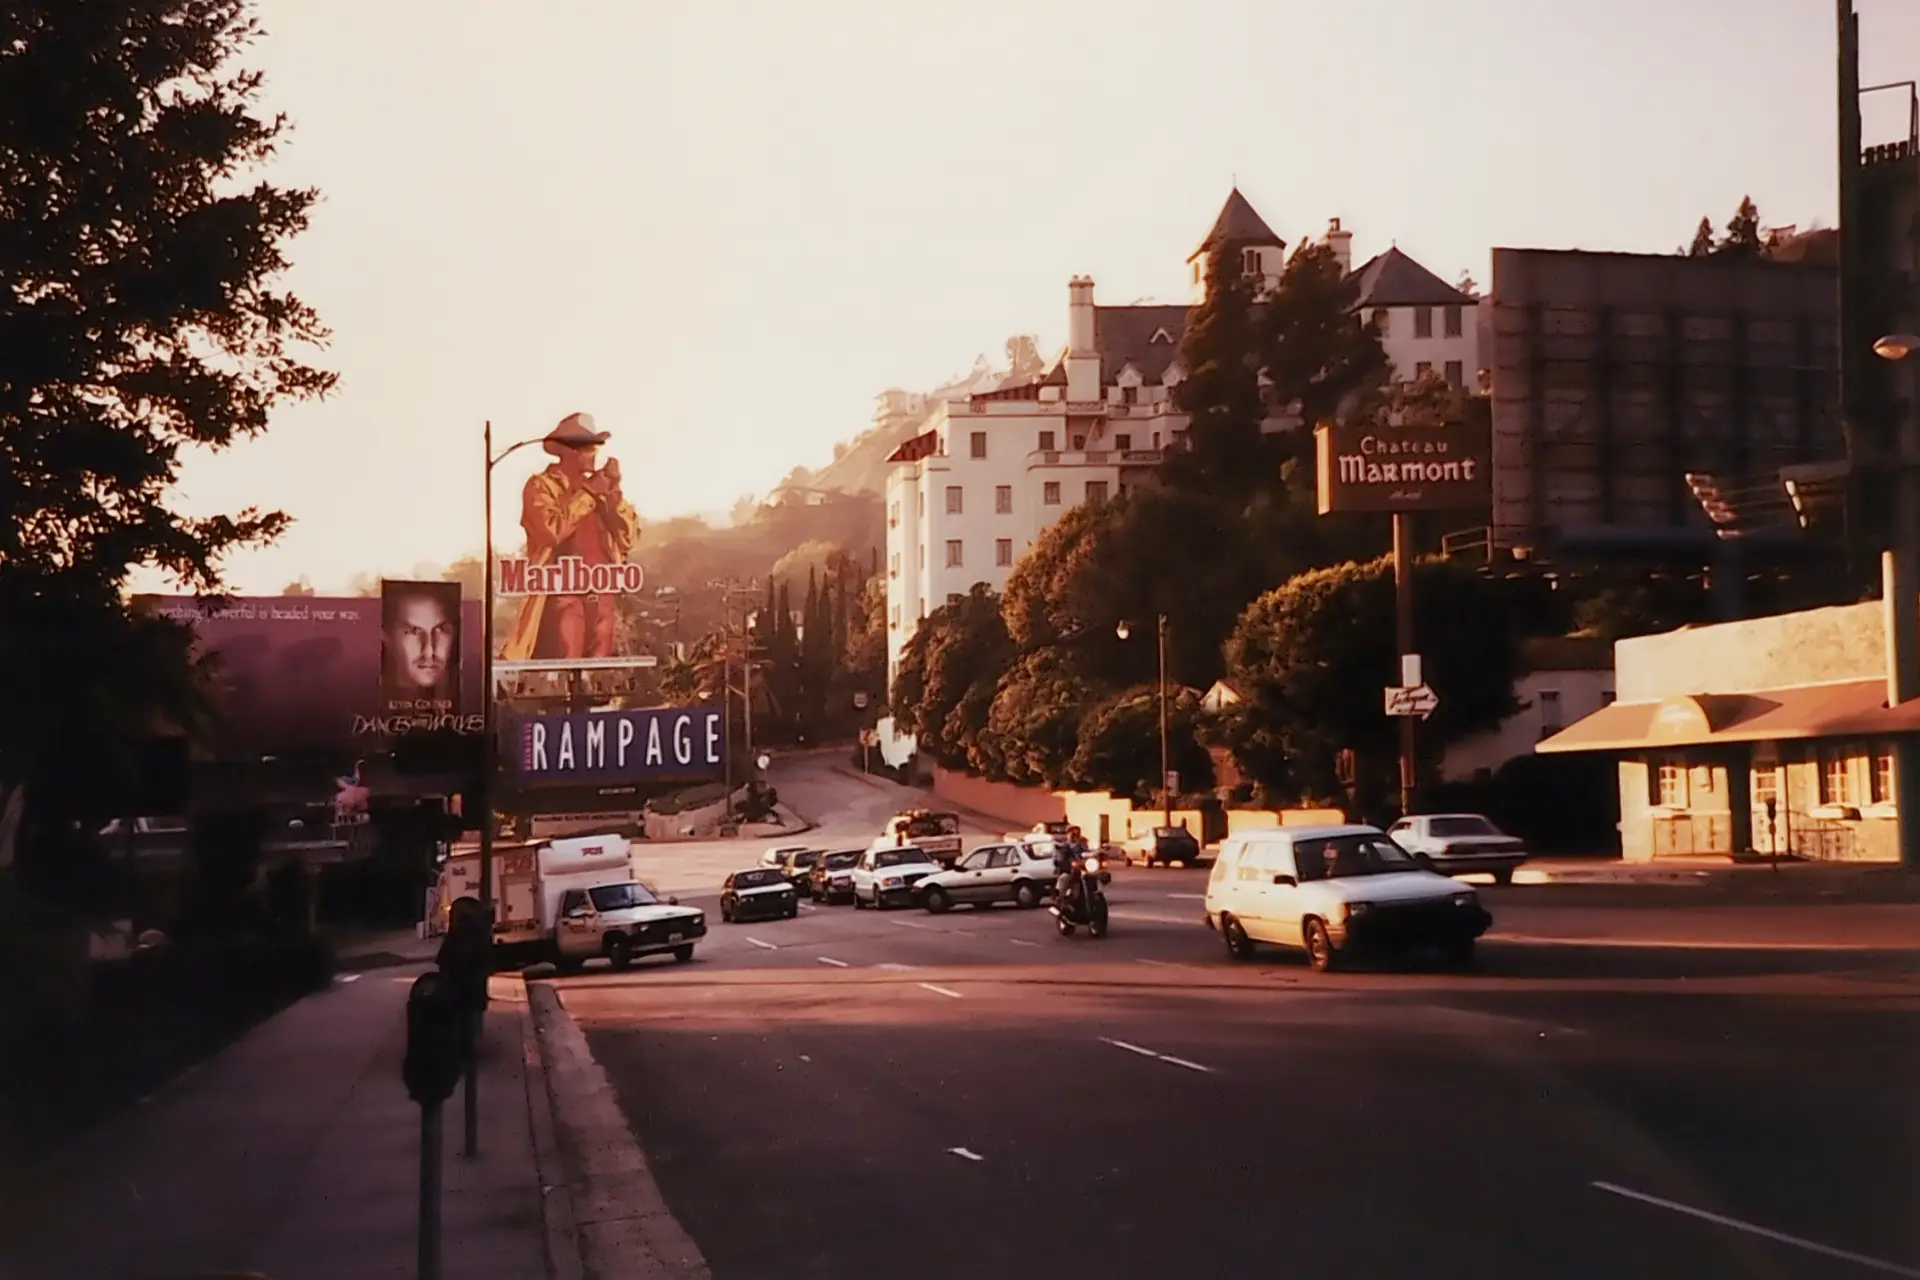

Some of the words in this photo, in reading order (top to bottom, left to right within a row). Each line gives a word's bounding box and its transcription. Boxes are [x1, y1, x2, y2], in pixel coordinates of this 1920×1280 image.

[1360, 435, 1448, 454] Chateau
[1339, 454, 1476, 483] Marmont
[499, 557, 643, 595] Marlboro
[259, 605, 268, 619] is
[272, 605, 308, 620] headed
[311, 610, 335, 627] your
[533, 714, 720, 771] RAMPAGE
